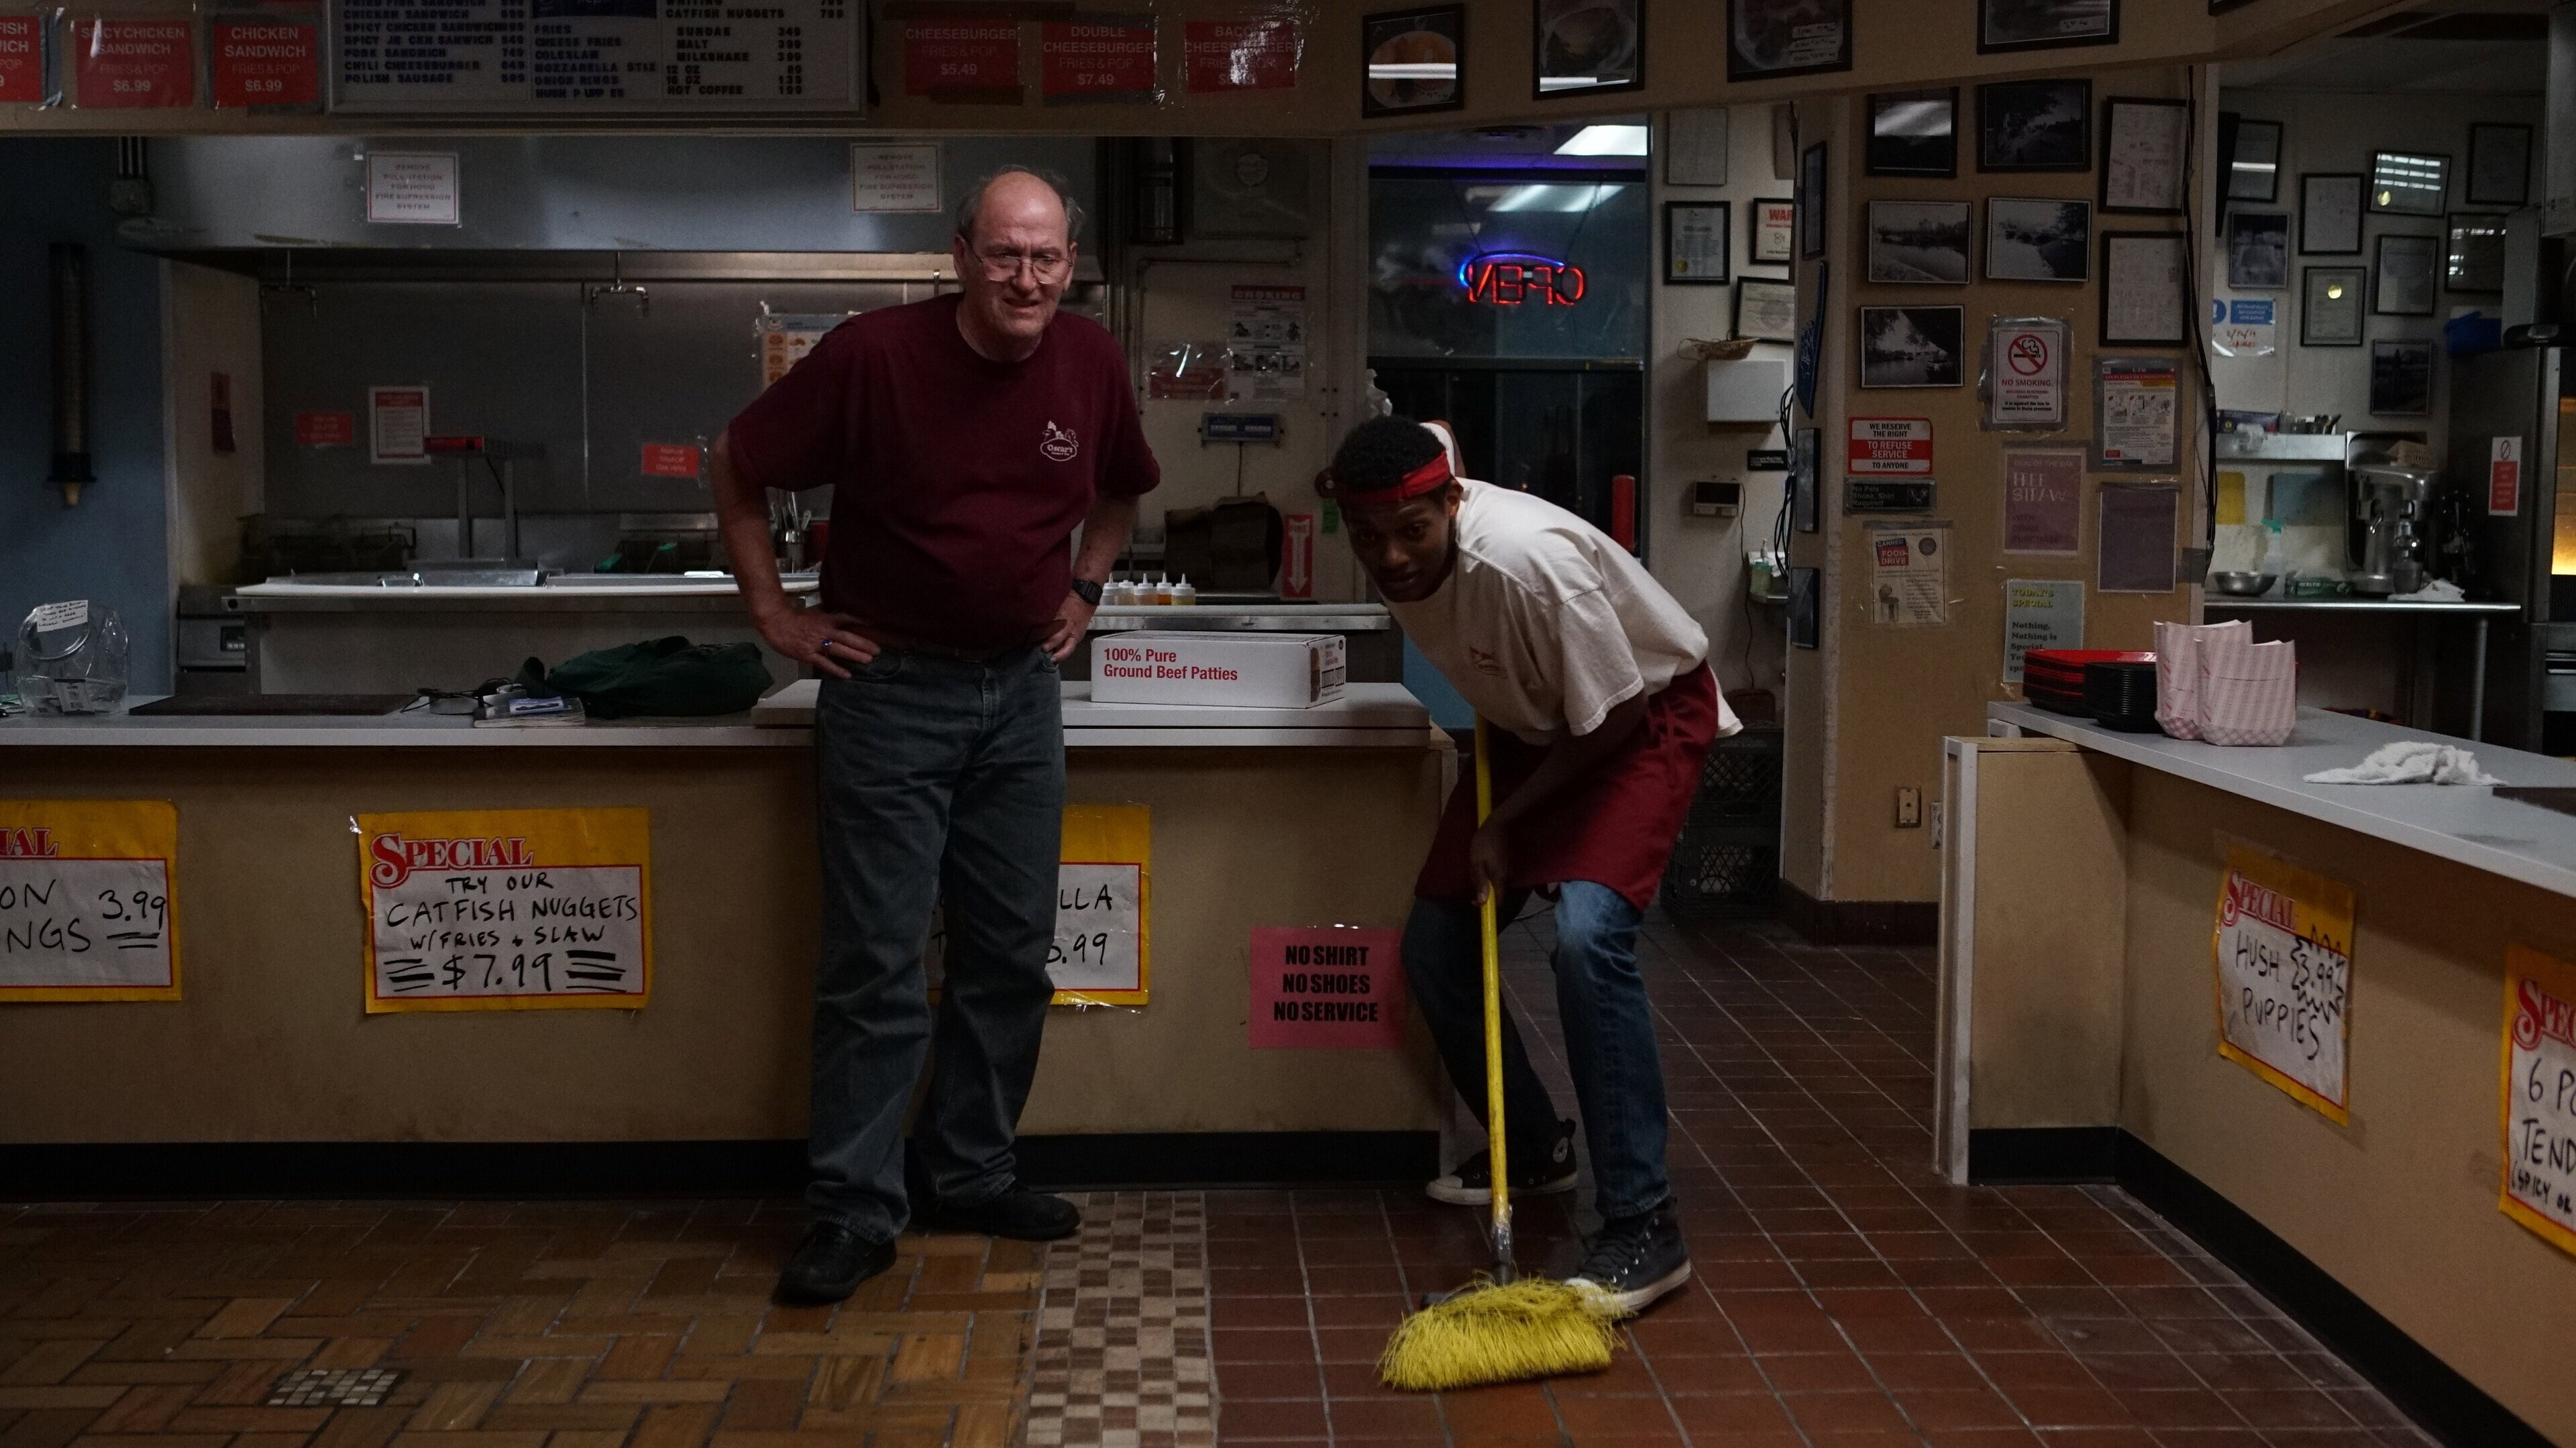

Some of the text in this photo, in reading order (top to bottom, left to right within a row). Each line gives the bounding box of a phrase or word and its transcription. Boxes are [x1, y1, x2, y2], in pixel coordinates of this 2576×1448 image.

[344, 10, 398, 19] CHICKEN
[405, 10, 469, 19] SANDWICH
[666, 9, 720, 19] CATFISH
[727, 9, 784, 19] NUGGETS
[0, 22, 28, 35] ISH
[123, 27, 184, 38] CHICKEN
[231, 27, 299, 40] CHICKEN
[345, 23, 381, 32] SPICY
[386, 23, 436, 32] CHICKEN
[441, 23, 501, 32] SANDWICH
[535, 25, 571, 34] FRIES
[677, 27, 731, 36] SUNDAE
[1071, 25, 1126, 38] DOUBLE
[906, 28, 1017, 40] CHEESEBURGER
[0, 40, 29, 52] ICH
[345, 36, 380, 45] SPICY
[587, 37, 622, 46] FRIES
[677, 40, 708, 49] MALT
[99, 43, 171, 55] SANDWICH
[225, 45, 306, 58] SANDWICH
[345, 48, 524, 58] PORK SANDWICH 749
[922, 45, 997, 57] FRIES & POP
[1043, 42, 1153, 54] CHEESEBURGER
[535, 50, 598, 60] COLESLAW
[677, 52, 749, 62] MILKSHAKE
[345, 61, 378, 70] CHILI
[535, 62, 656, 72] MOZZARELLA STIX
[685, 65, 700, 74] OZ
[941, 63, 977, 75] $5.49
[1059, 58, 1134, 69] FRIES & POP
[345, 74, 390, 83] POLISH
[397, 74, 453, 83] SAUSAGE
[535, 76, 619, 85] ONION RINGS
[685, 76, 700, 85] OZ
[1077, 74, 1114, 85] $7.49
[113, 80, 151, 92] $6.99
[244, 80, 282, 92] $6.99
[667, 85, 691, 95] HOT
[699, 85, 743, 95] COFFEE
[535, 89, 566, 98] HUSH
[1868, 441, 1913, 449] TO REFUSE
[1872, 450, 1908, 459] SERVICE
[2012, 632, 2048, 641] Nothing
[1104, 648, 1177, 663] 100% Pure
[1104, 664, 1238, 681] Ground Beef Patties
[370, 832, 535, 889] SPECIAL
[445, 872, 553, 894] TRY OUR
[2223, 869, 2298, 932] SPECIAL
[99, 889, 167, 930] 3.99
[386, 895, 638, 927] CATFISH NUGGETS
[534, 925, 605, 945] SLAW
[1285, 945, 1369, 966] NO SHIRT
[2236, 930, 2279, 983] HUSH
[442, 952, 552, 992] $7.99
[1283, 973, 1371, 995] NO SHOES
[1274, 1001, 1379, 1022] NO SERVICE
[2243, 987, 2319, 1060] PUPPIES
[2528, 1057, 2544, 1103] 6
[2557, 1193, 2573, 1214] OR
